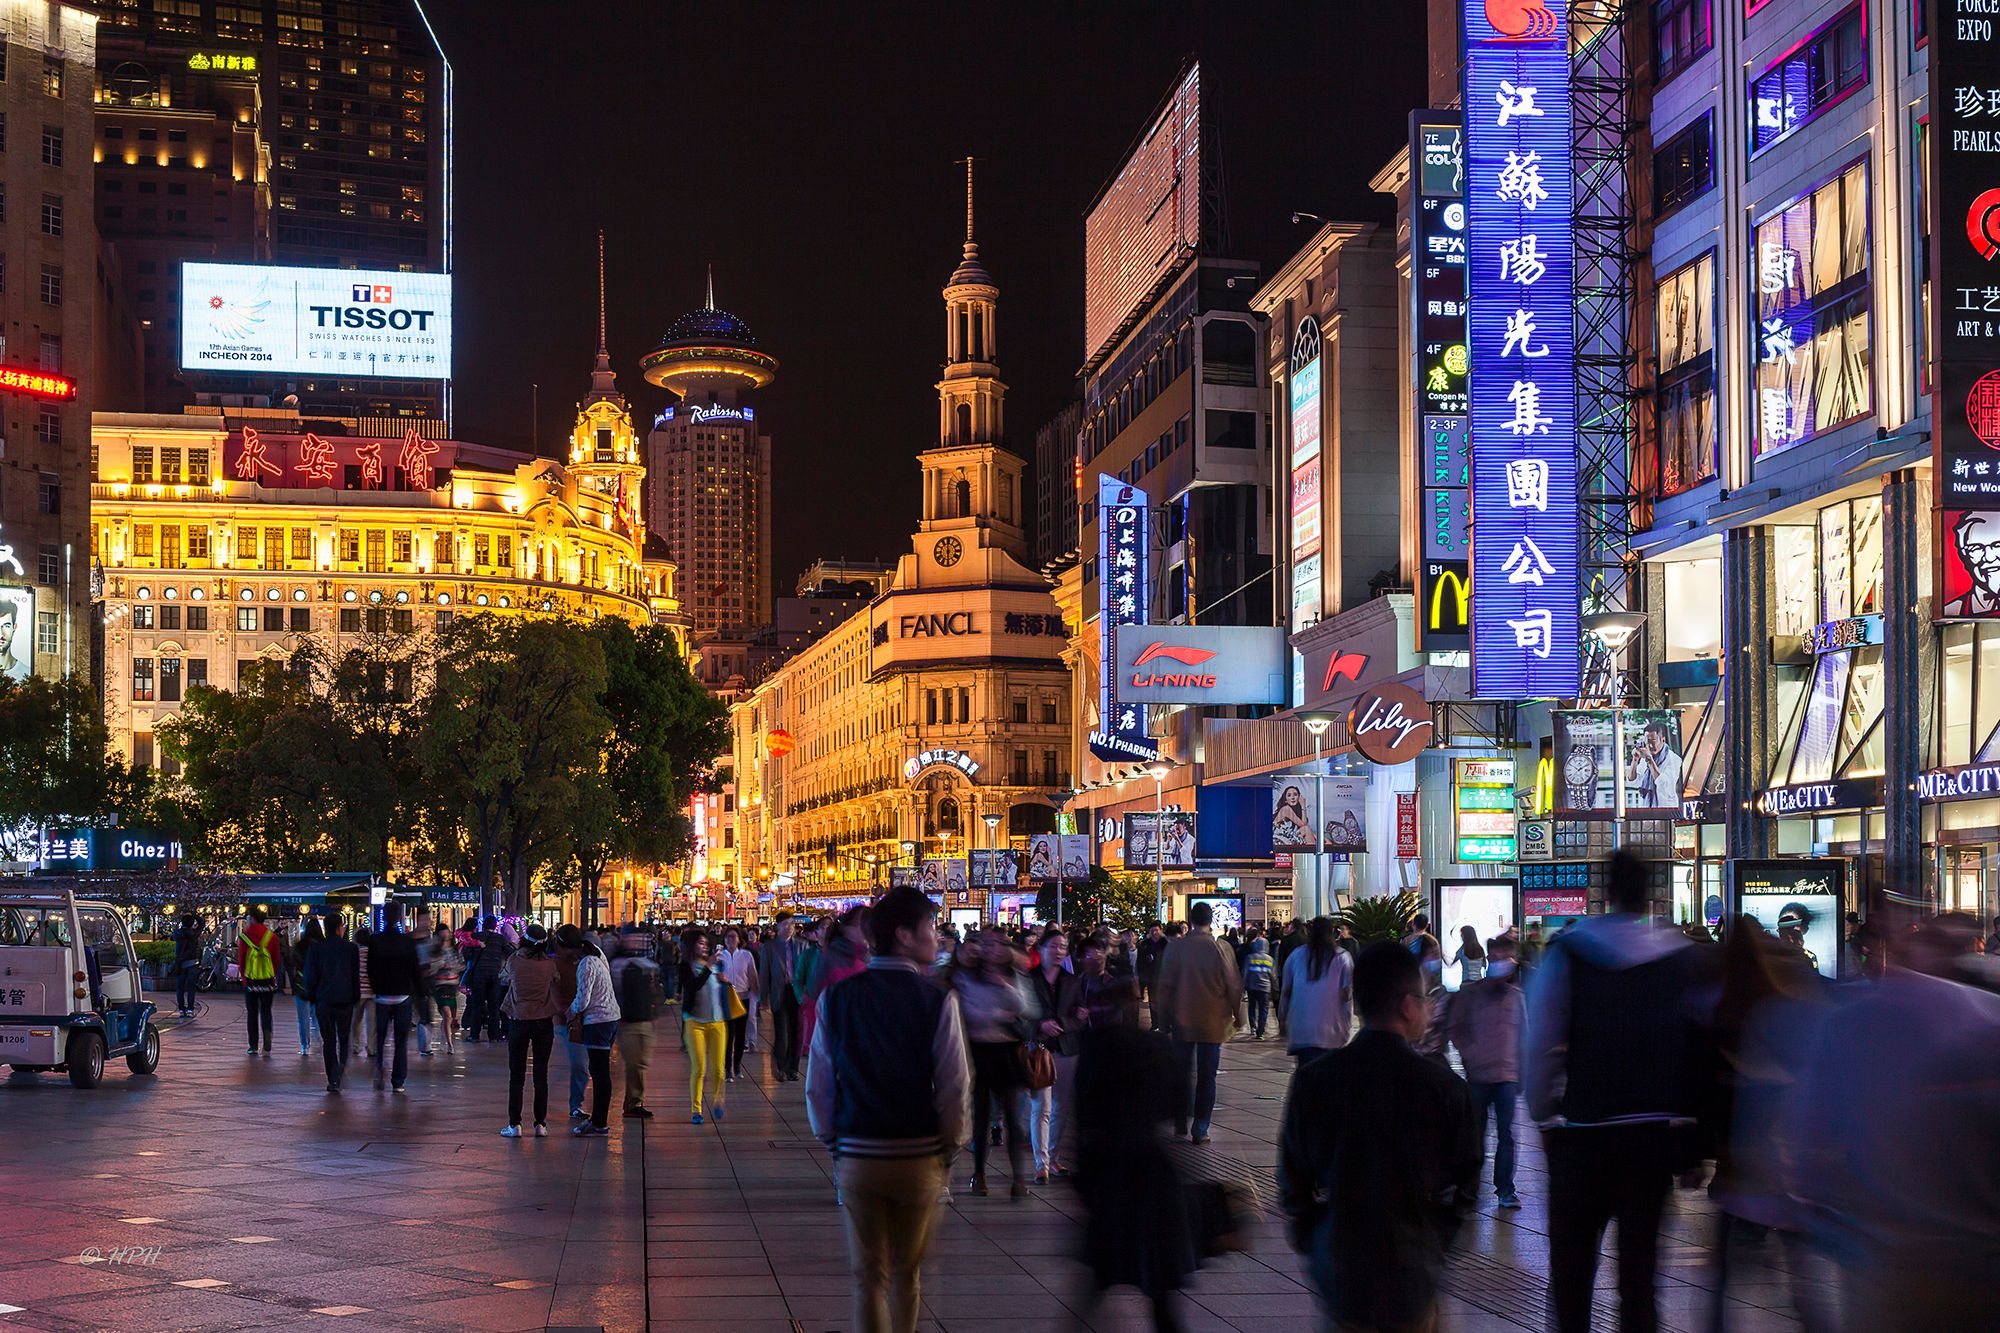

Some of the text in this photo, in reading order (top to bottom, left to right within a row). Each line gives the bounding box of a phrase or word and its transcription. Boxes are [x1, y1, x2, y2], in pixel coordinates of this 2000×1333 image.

[1957, 19, 1992, 41] EXPO
[1425, 134, 1439, 144] 7F
[1953, 130, 2000, 152] PEARLS
[1424, 200, 1438, 210] 6F
[1426, 269, 1440, 278] 5F
[310, 306, 434, 331] TISSOT
[1957, 321, 1994, 337] ART &
[342, 334, 382, 342] WATCHES
[199, 351, 273, 361] INCHEON 2014
[1426, 345, 1441, 355] 4F
[1426, 367, 1449, 391] 康
[1496, 80, 1557, 658] 江蘇陽光集團公司
[0, 370, 68, 396] 扬黄浦精神
[690, 403, 742, 424] Radisson
[1430, 420, 1458, 430] 2-3F
[1952, 459, 2000, 479] 新世
[1435, 432, 1450, 546] SILK KING
[1953, 483, 1977, 493] New
[1115, 528, 1137, 625] 上海市第
[1430, 565, 1443, 575] B1
[901, 611, 981, 638] FANCL
[1133, 673, 1217, 688] LI-NING
[1356, 696, 1434, 749] Lily
[1089, 730, 1160, 761] NO.1 PHARMACY
[1919, 767, 2000, 798] ME&CITY
[1764, 784, 1836, 812] ME&CITY
[121, 841, 166, 858] Chez
